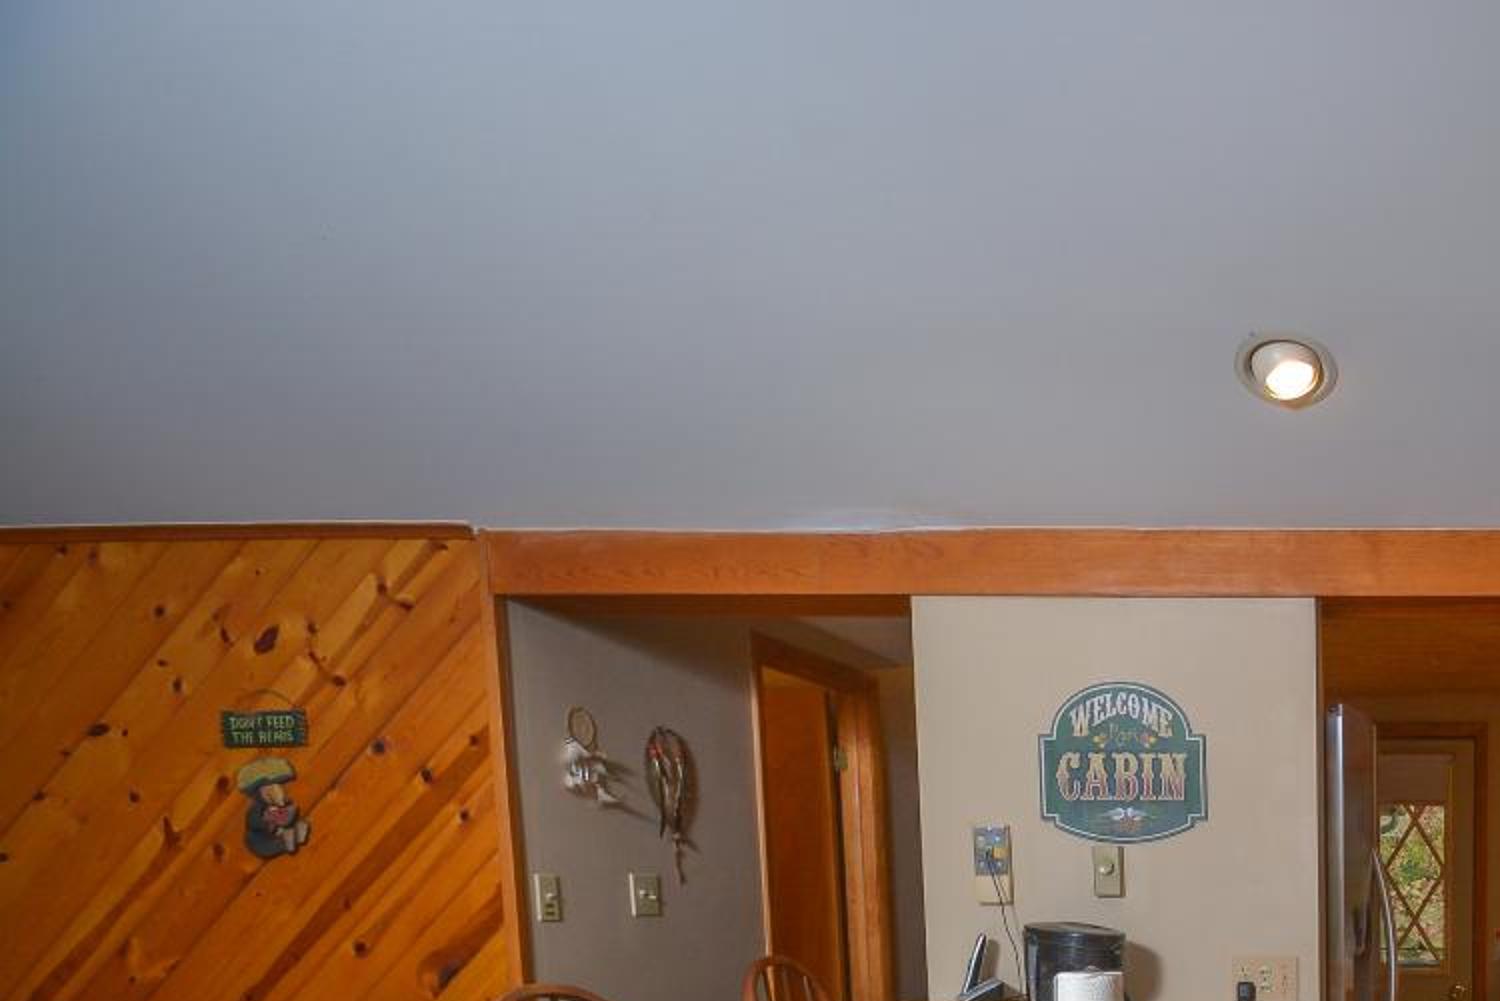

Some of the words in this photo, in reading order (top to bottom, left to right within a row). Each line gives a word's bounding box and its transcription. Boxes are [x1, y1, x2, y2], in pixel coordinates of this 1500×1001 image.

[265, 714, 295, 729] FEED
[1070, 691, 1173, 737] WELCOME
[232, 730, 254, 744] THE
[1055, 751, 1187, 801] CABIN
